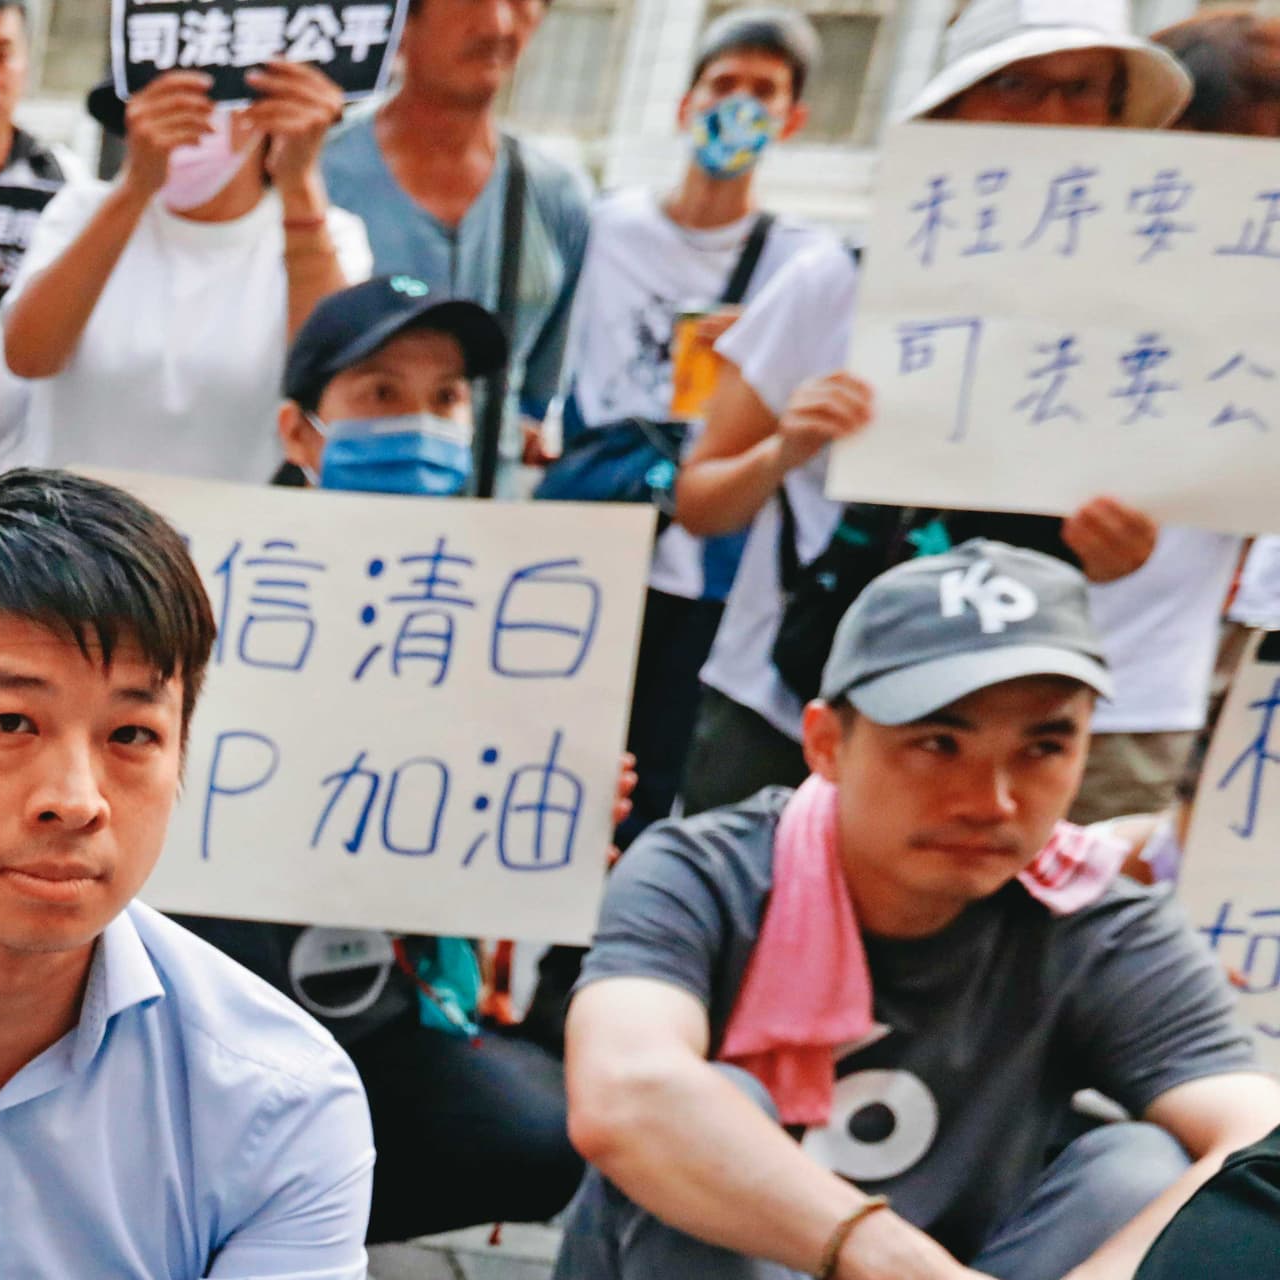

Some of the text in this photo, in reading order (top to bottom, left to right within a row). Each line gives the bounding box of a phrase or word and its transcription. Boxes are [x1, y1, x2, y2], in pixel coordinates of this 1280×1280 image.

[127, 5, 389, 70] 司法要公平
[213, 537, 603, 688] 信清白
